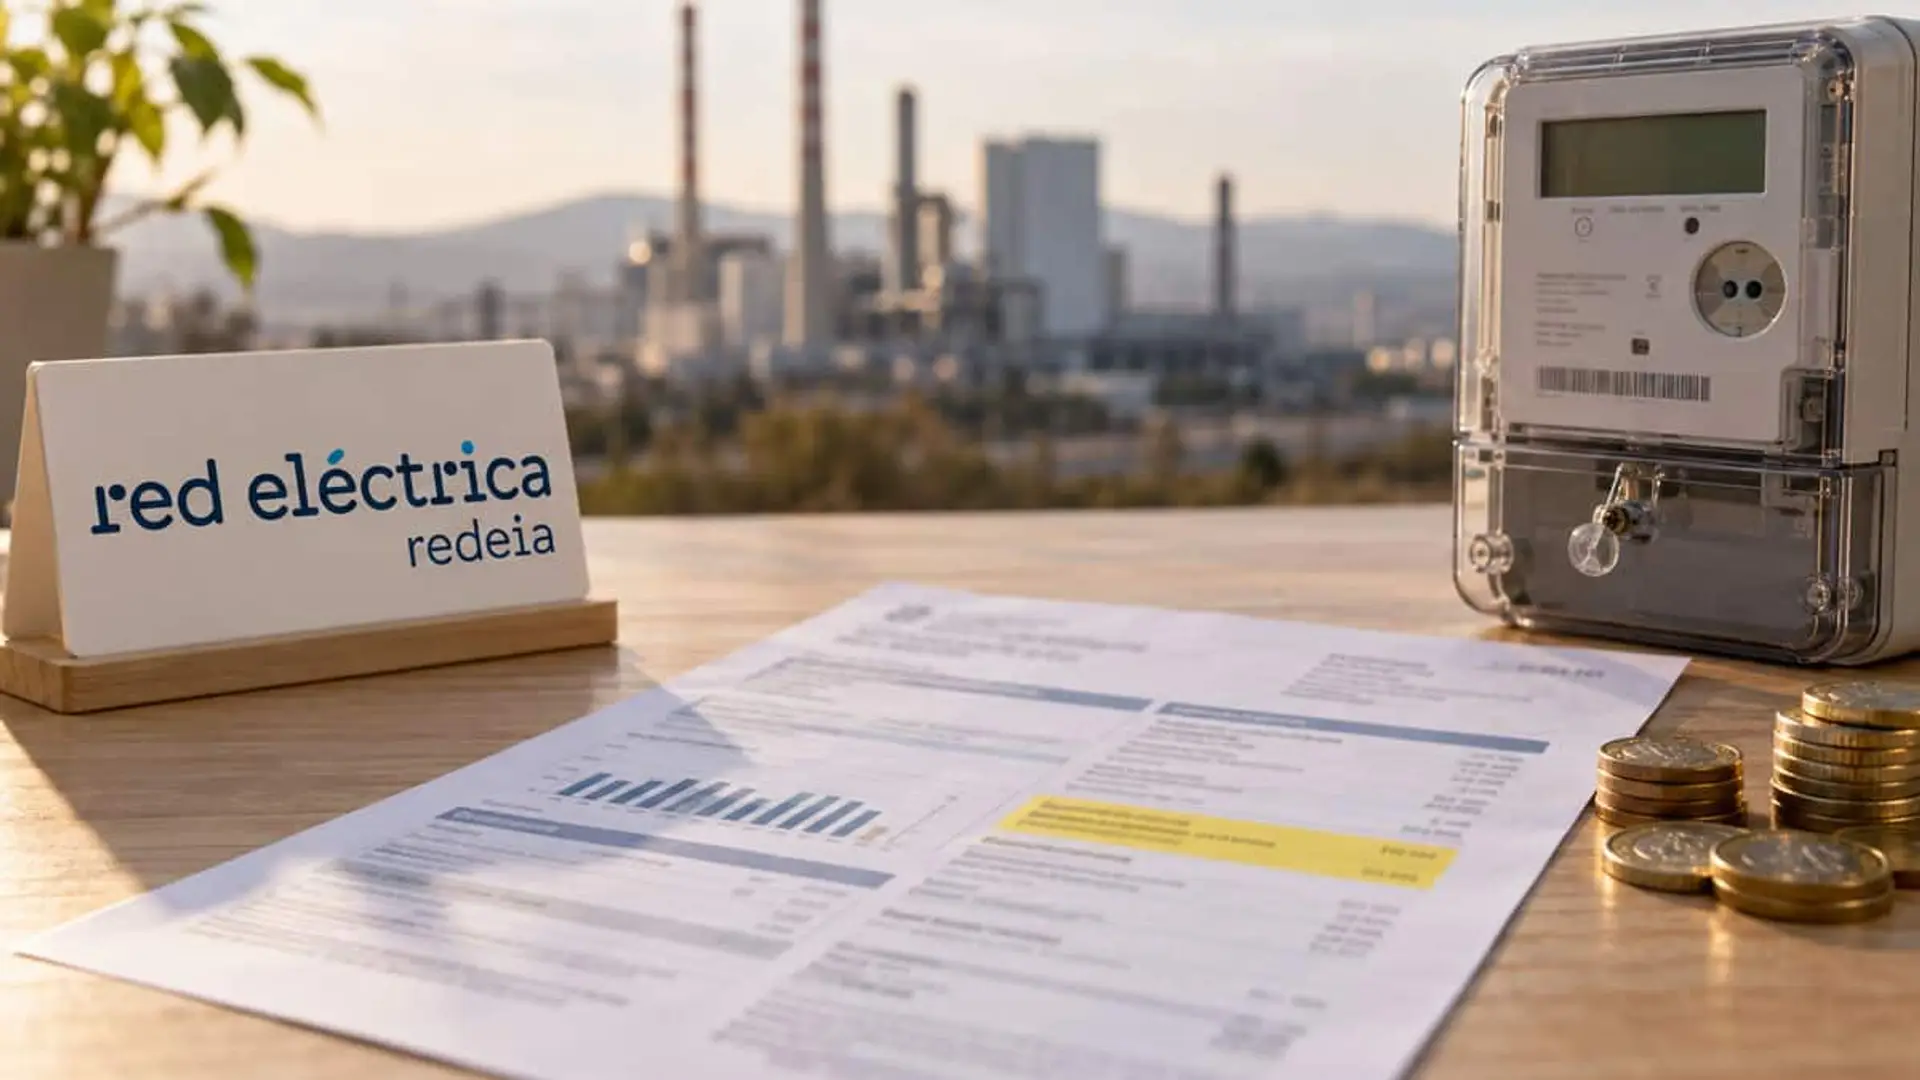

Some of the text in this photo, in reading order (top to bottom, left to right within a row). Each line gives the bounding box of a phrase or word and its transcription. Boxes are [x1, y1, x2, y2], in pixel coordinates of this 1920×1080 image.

[90, 440, 552, 535] red eléctrica
[407, 514, 556, 568] redeia
